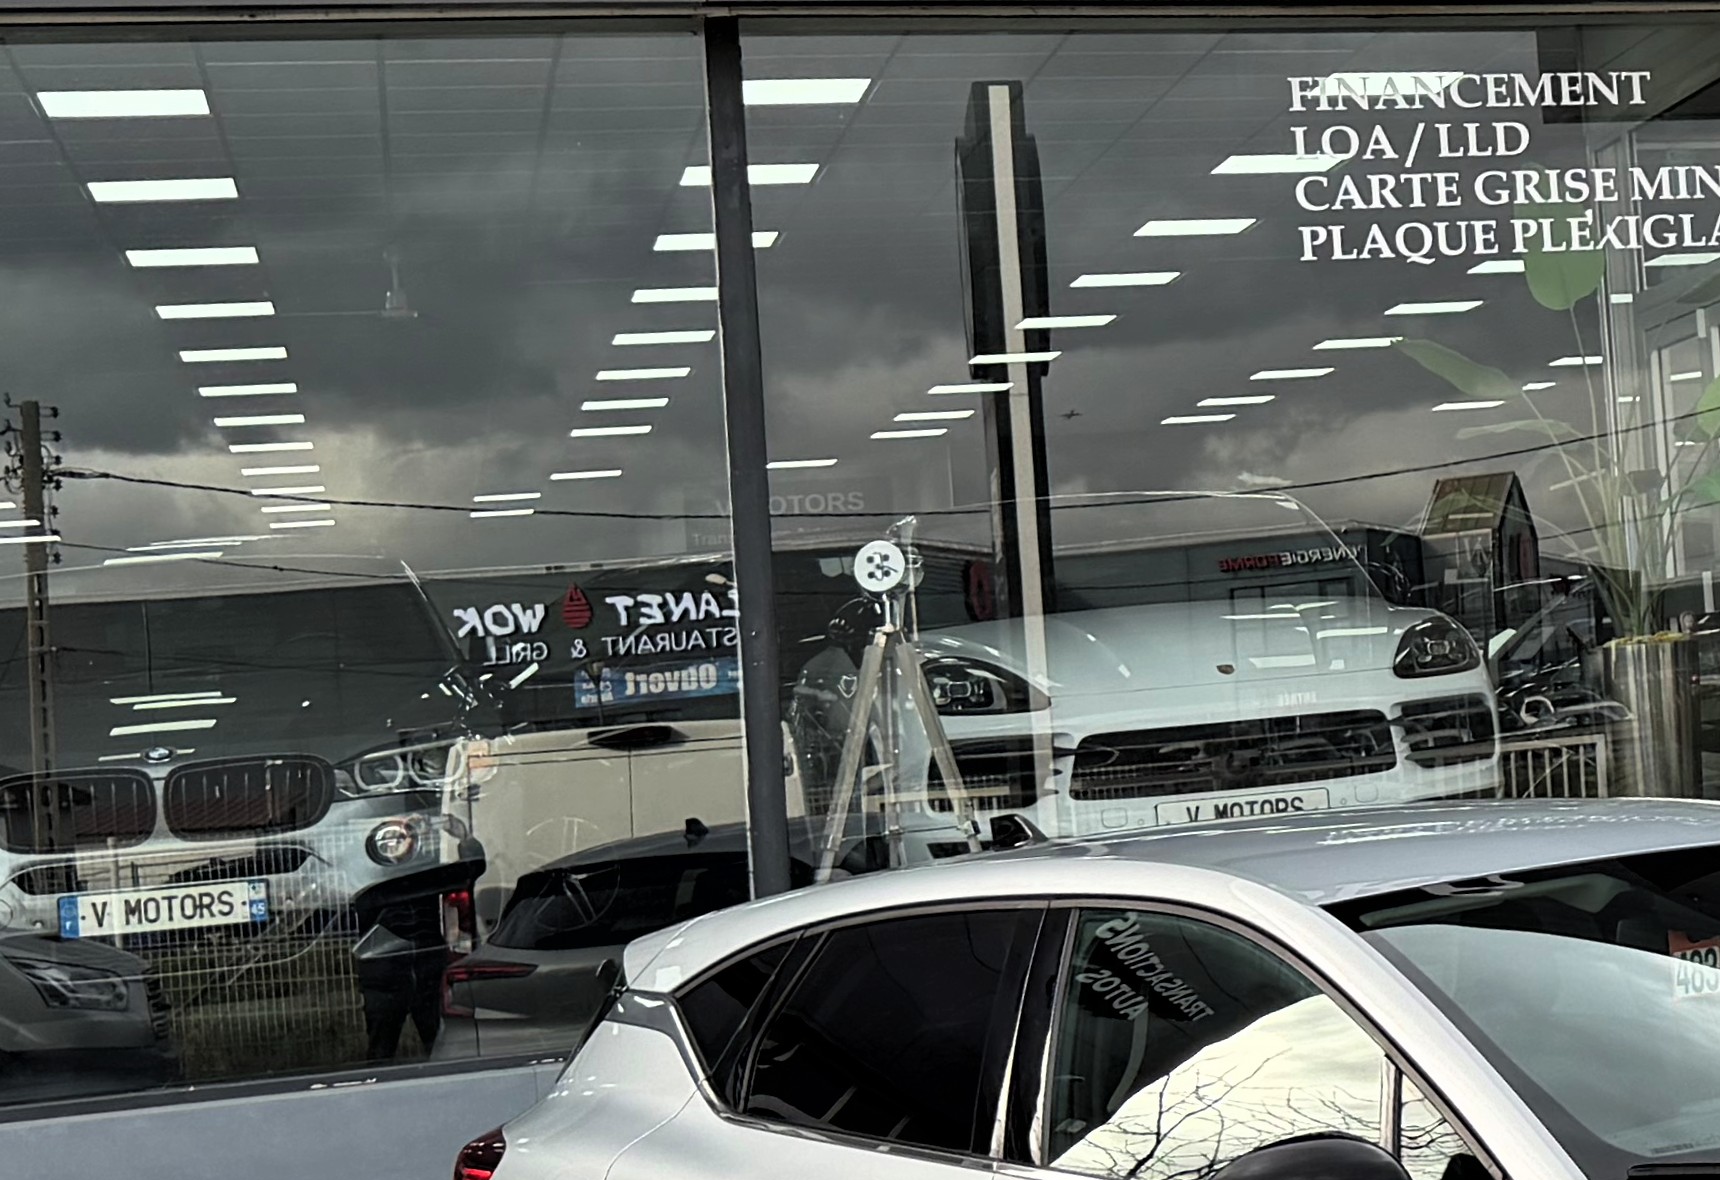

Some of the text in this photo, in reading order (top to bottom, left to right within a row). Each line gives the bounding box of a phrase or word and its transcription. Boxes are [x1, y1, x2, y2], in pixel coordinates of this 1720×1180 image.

[1288, 72, 1651, 112] FINANCEMENT
[1295, 172, 1462, 212] CARTE
[1474, 168, 1618, 206] GRISE
[1299, 219, 1500, 265] PLAQUE
[91, 902, 108, 928] V
[124, 890, 235, 926] MOTORS
